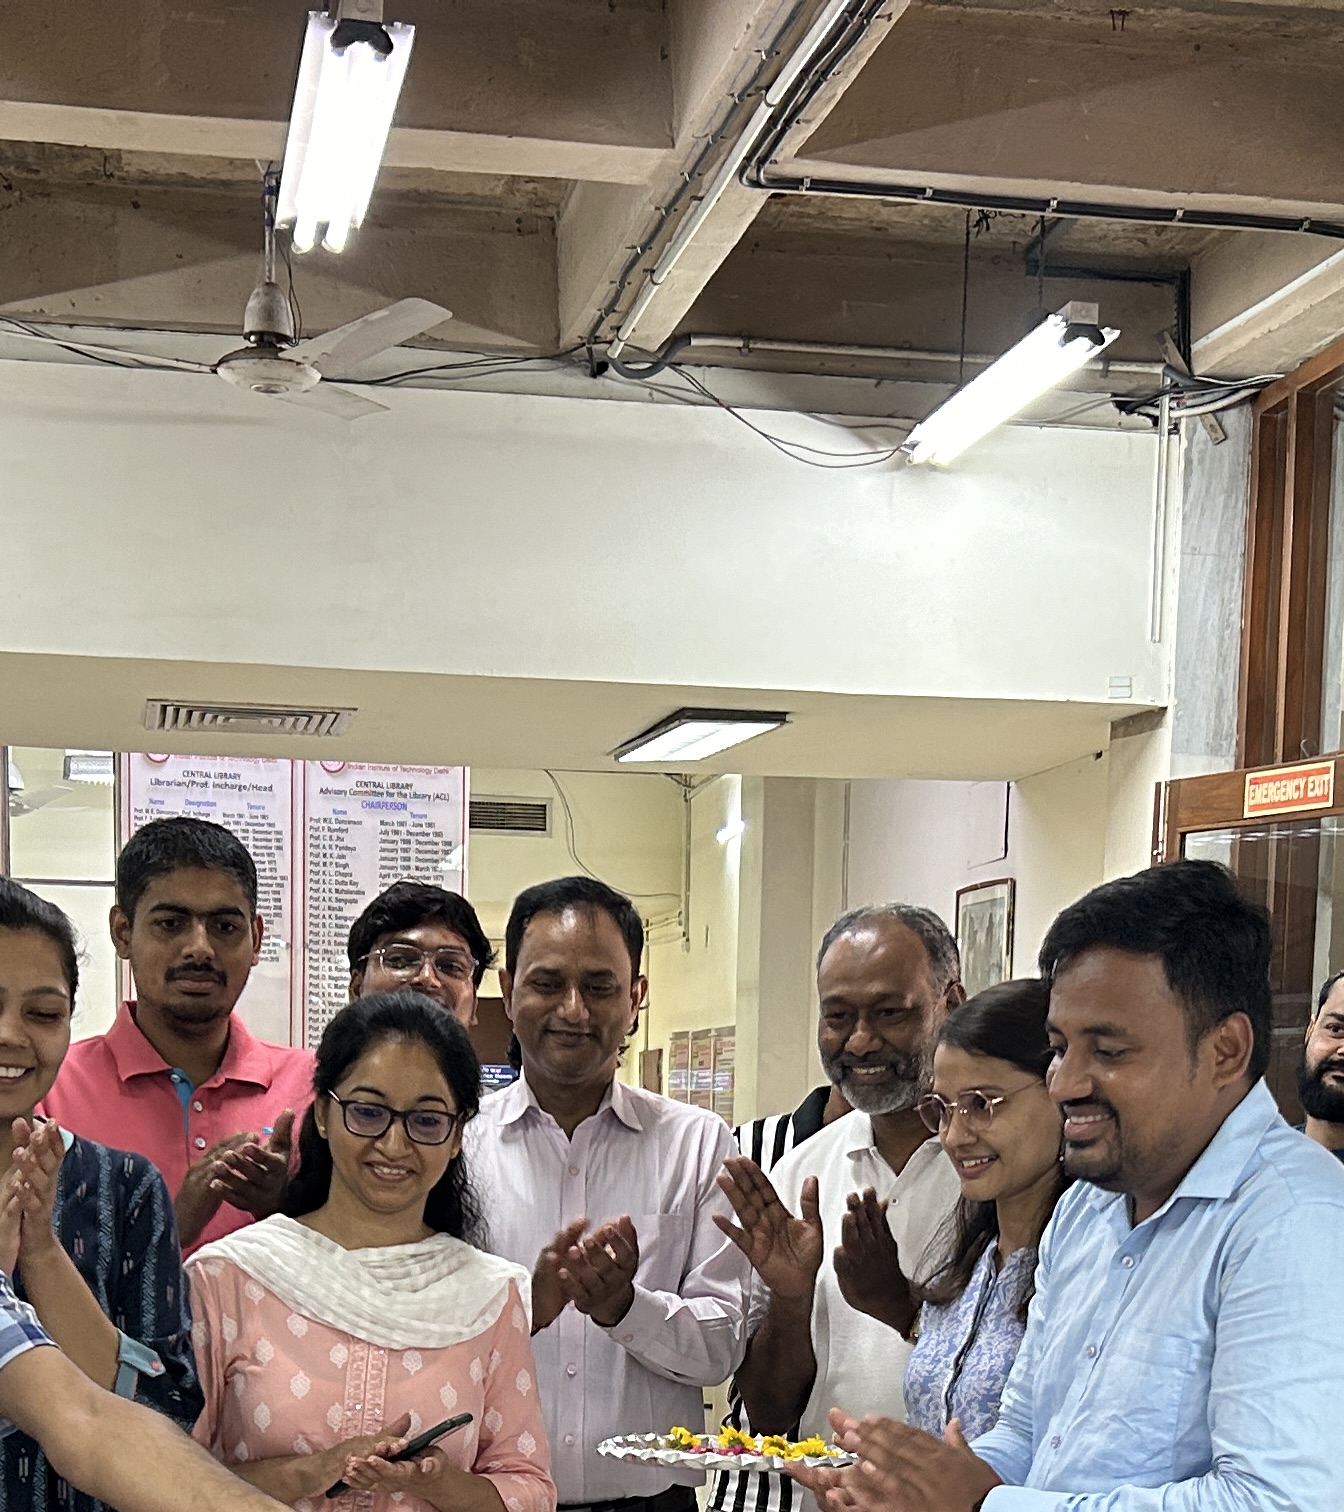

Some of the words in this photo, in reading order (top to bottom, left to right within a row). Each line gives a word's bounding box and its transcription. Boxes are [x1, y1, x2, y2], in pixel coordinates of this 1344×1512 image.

[182, 770, 212, 779] CENTRAL
[213, 772, 241, 780] LIBRARY
[212, 781, 273, 792] Incharge/Head
[356, 780, 384, 789] CENTRAL
[386, 782, 413, 791] LIBRARY
[1249, 777, 1307, 806] EMERGENCY
[1307, 774, 1330, 798] EXIT
[319, 787, 347, 797] Advisory
[349, 788, 384, 798] Committee
[386, 789, 395, 798] for
[396, 790, 407, 799] the
[409, 792, 431, 801] Library
[433, 793, 449, 802] (ACL)
[361, 800, 407, 811] CHAIRPERSON
